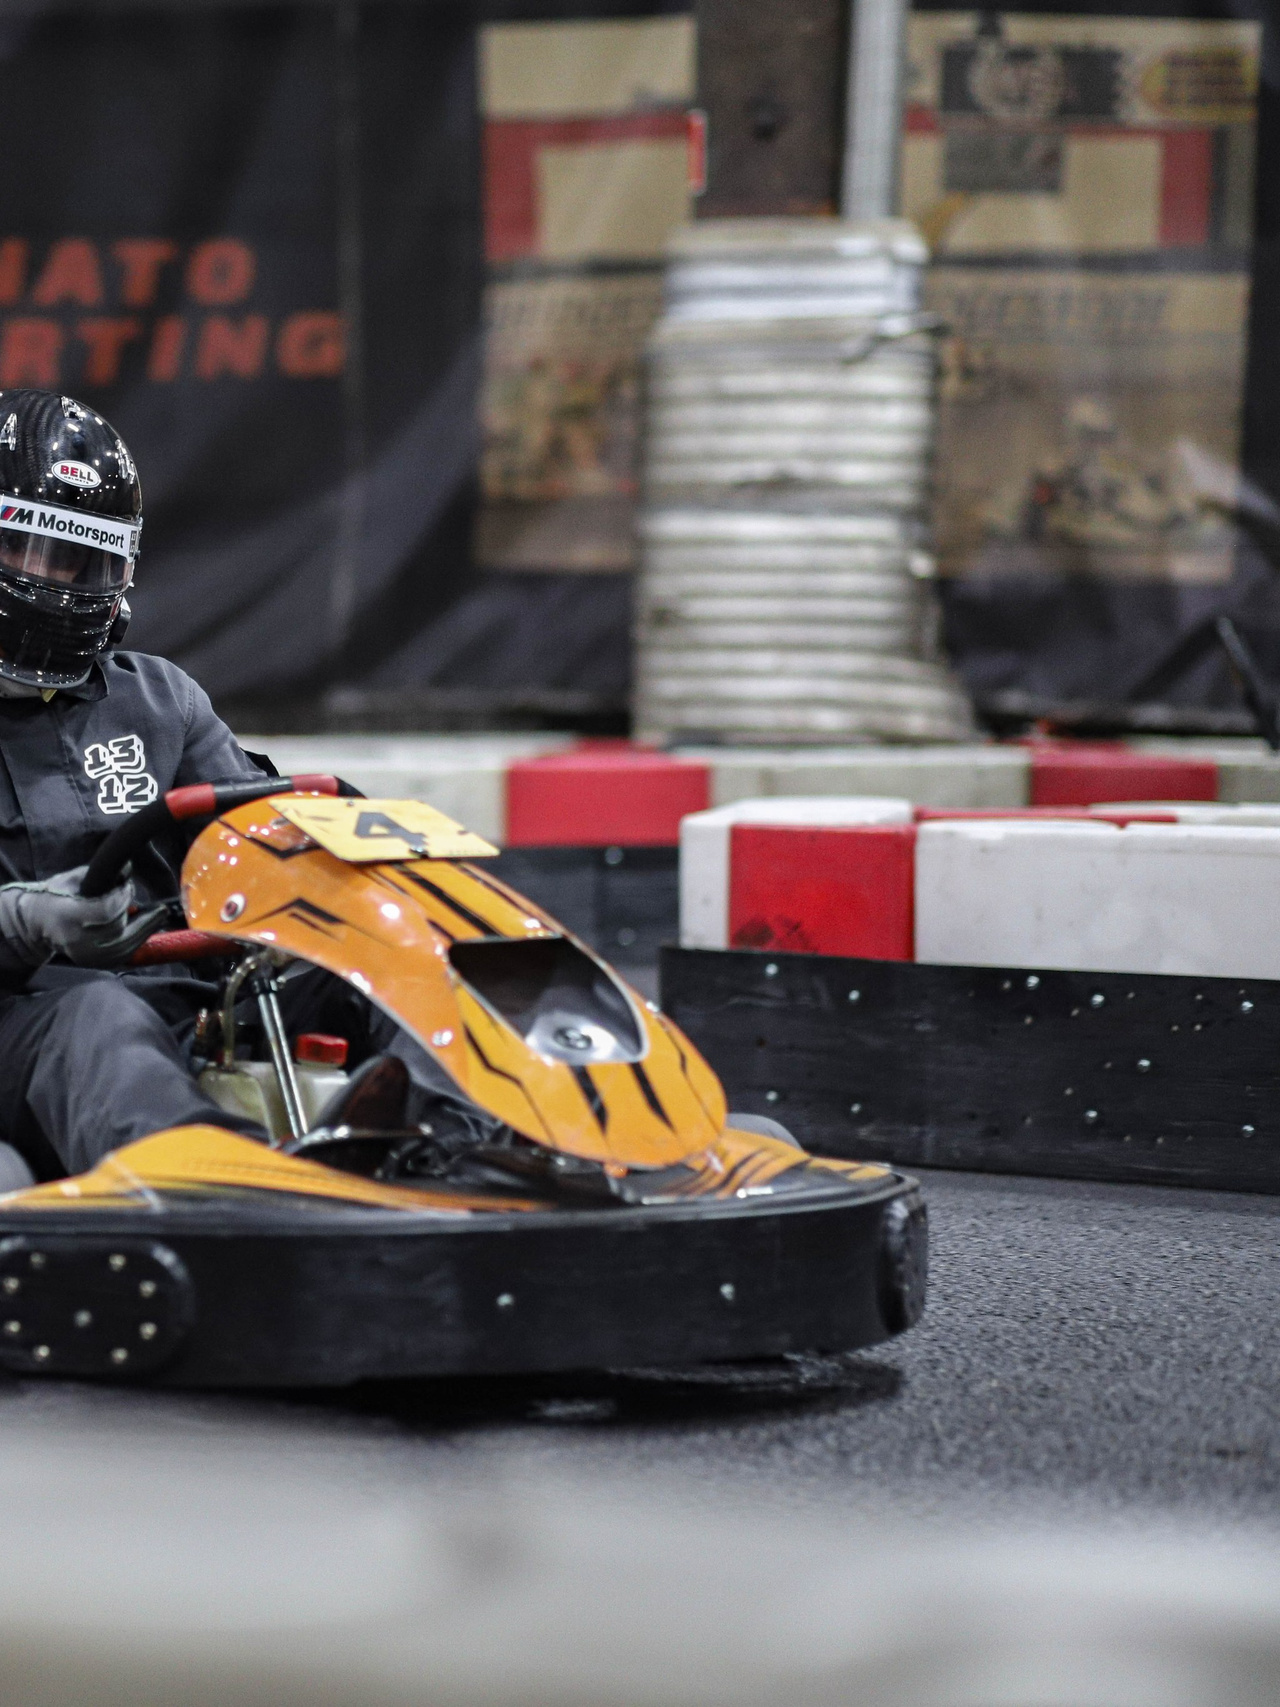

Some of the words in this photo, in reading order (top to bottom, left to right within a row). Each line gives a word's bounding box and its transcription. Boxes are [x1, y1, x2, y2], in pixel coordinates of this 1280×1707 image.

[60, 465, 93, 482] BELL
[37, 512, 124, 549] Motorsport
[85, 734, 145, 779] 13
[98, 773, 158, 814] 12
[353, 811, 428, 851] 4
